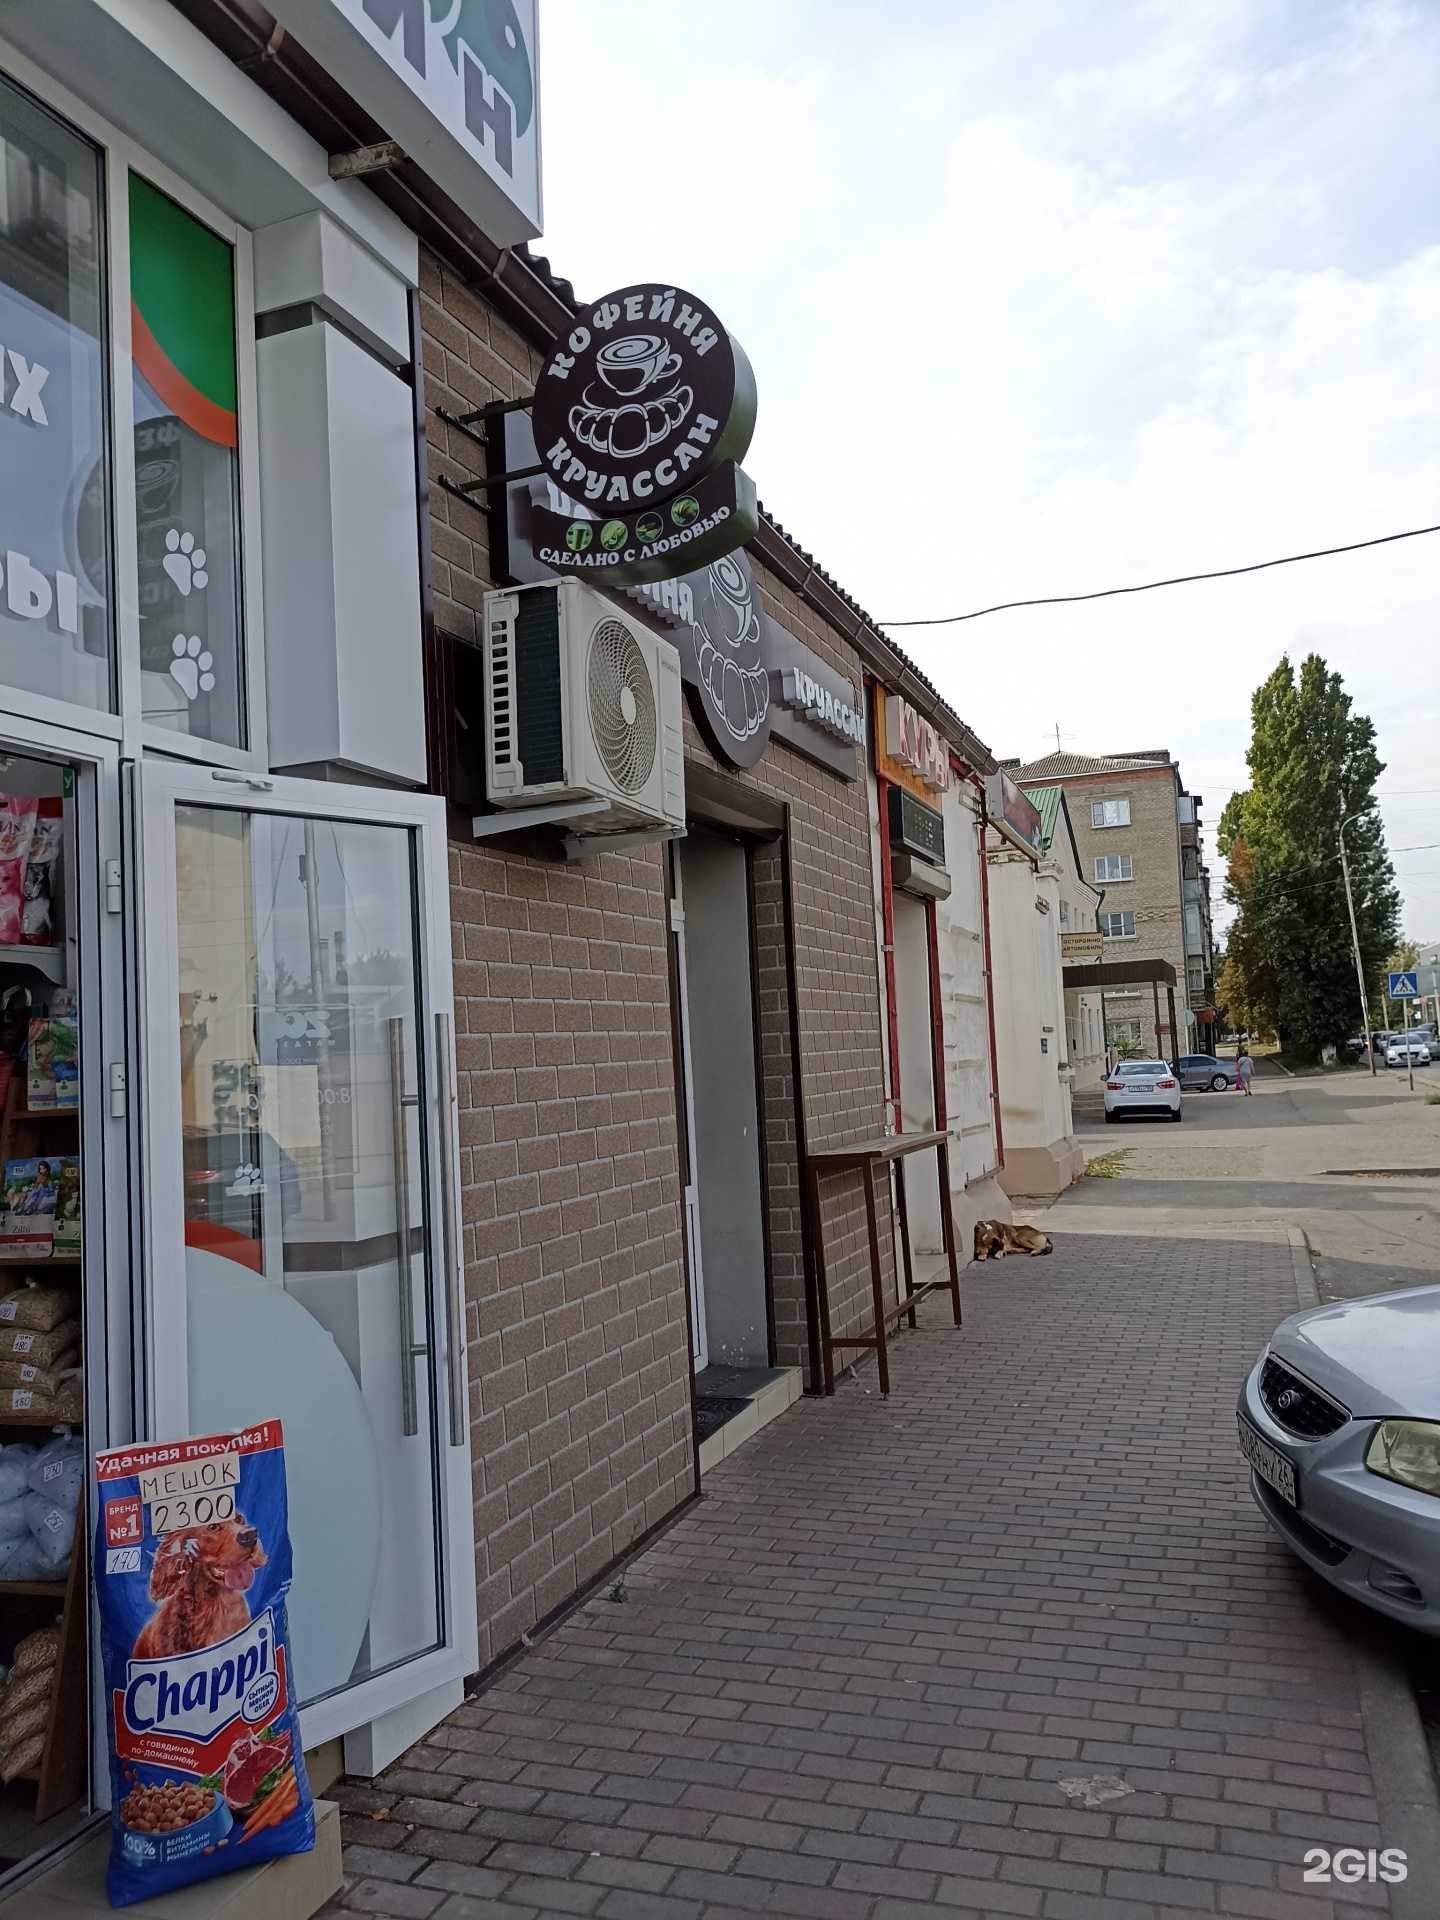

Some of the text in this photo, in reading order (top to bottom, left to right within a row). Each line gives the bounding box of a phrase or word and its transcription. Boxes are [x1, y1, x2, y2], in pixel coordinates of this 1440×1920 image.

[548, 289, 718, 379] КОФЕЙНЯ
[546, 413, 719, 501] КРУАССАН
[539, 505, 730, 566] СДЕЛАНО С ЛЮБОВЬЮ
[96, 1426, 269, 1473] Удачная покупка!
[143, 1462, 236, 1499] МЕШОК
[109, 1503, 139, 1516] БРЕНД
[155, 1494, 234, 1533] 2300
[125, 1627, 269, 1732] Chappi
[146, 1741, 195, 1756] говядиной
[123, 1832, 156, 1857] 100%
